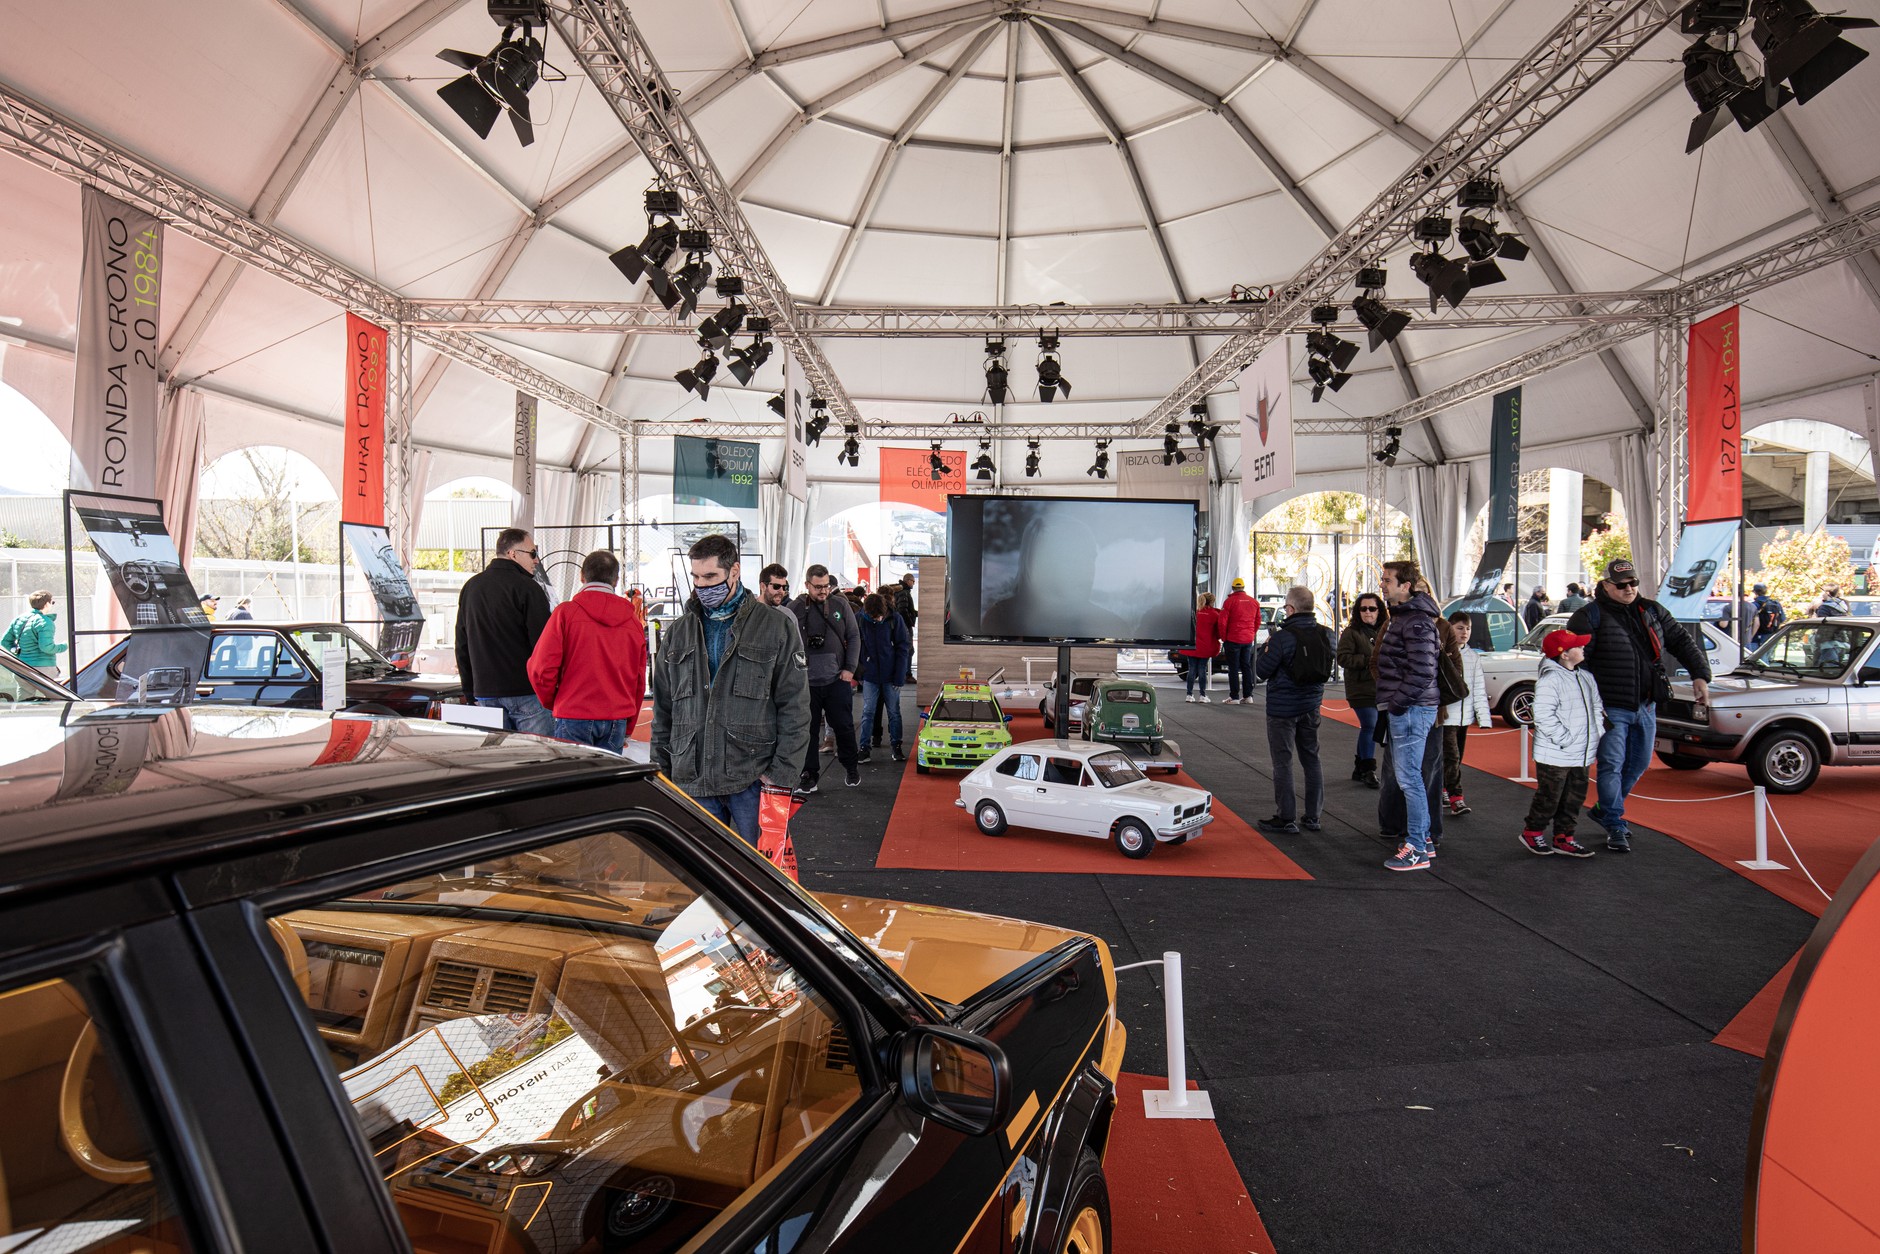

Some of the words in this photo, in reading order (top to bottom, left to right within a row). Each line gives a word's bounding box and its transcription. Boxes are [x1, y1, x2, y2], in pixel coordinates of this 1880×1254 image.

[134, 229, 159, 307] 1984
[107, 217, 128, 353] CRONO
[134, 318, 157, 370] 2.0
[1722, 380, 1737, 430] CLX
[102, 364, 128, 487] RONDA
[717, 444, 754, 458] TOLEDO
[921, 454, 962, 466] TOEDO
[1125, 455, 1150, 466] IBIZA
[1721, 438, 1736, 476] 127
[357, 436, 370, 497] FURA
[715, 459, 754, 472] PODIUM
[1180, 465, 1205, 477] 1989
[1254, 451, 1276, 482] SEAT
[731, 474, 754, 485] 1992
[911, 478, 962, 491] OLÍMPICO
[1794, 696, 1817, 704] CLX
